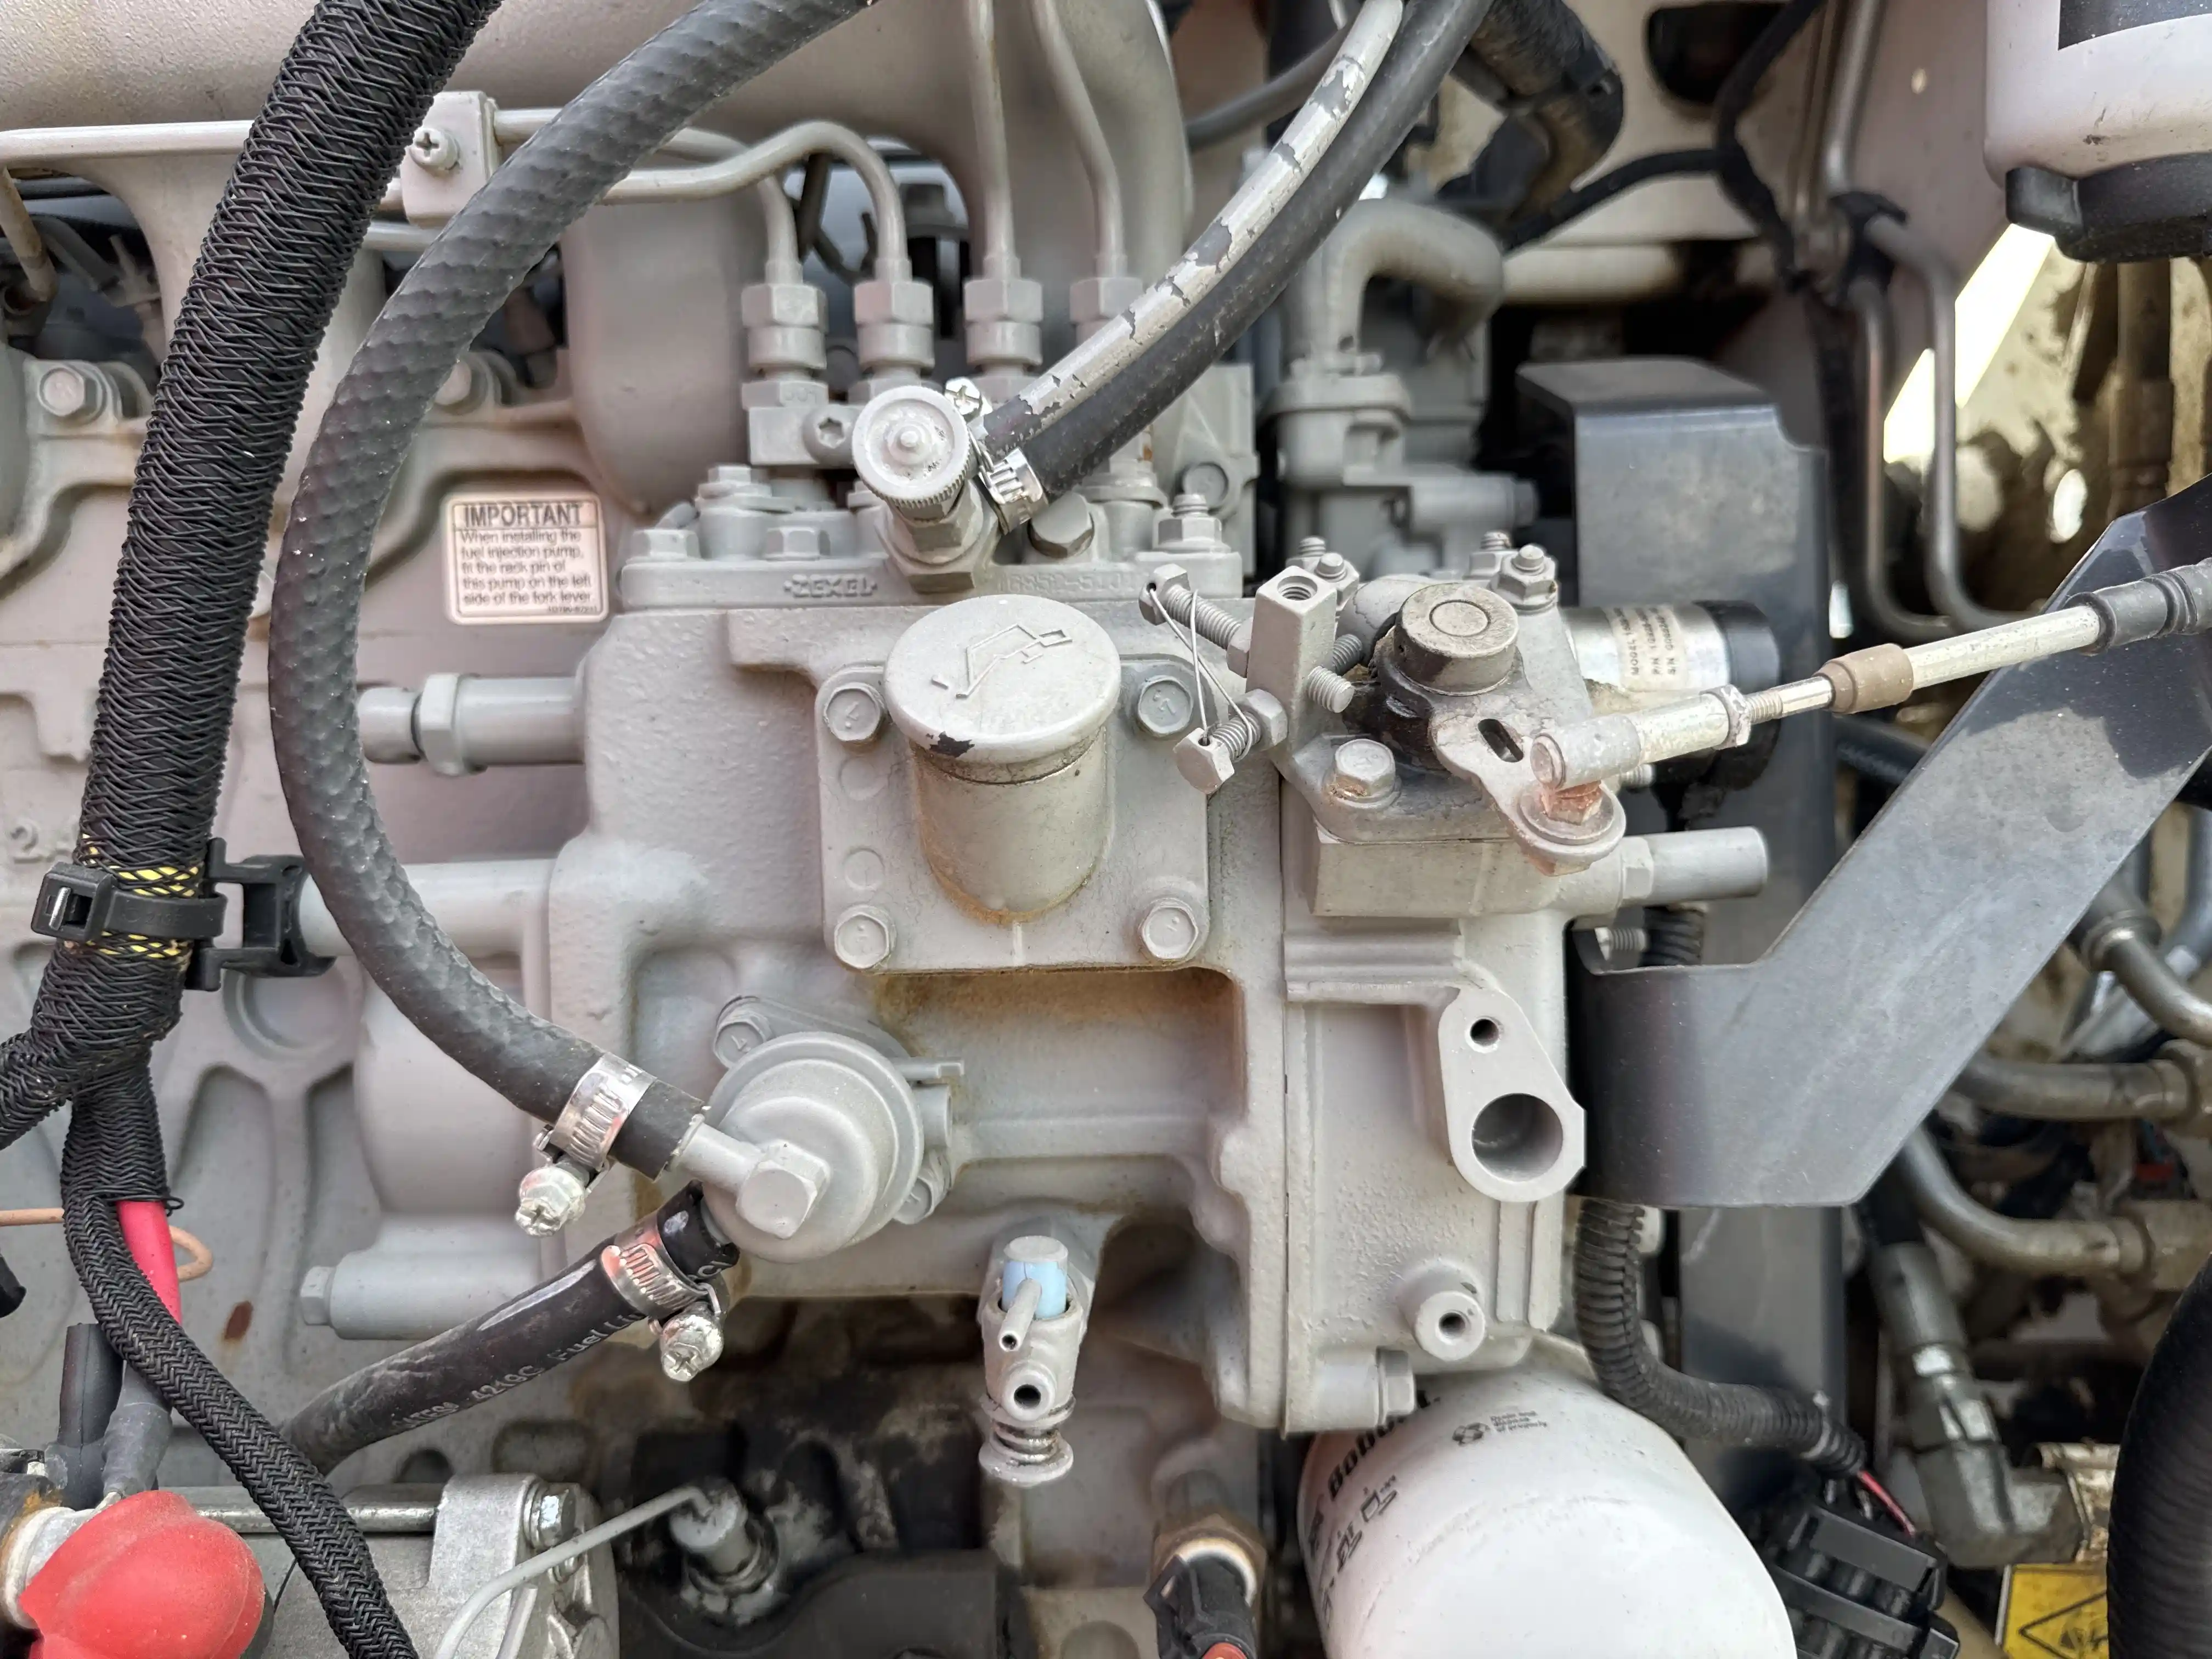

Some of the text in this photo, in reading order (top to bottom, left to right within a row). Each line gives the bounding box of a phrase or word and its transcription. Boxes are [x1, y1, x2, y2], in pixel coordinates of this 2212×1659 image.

[465, 503, 583, 527] IMPORTANT
[460, 526, 582, 545] When installing the
[461, 546, 484, 559] fuel
[488, 545, 540, 561] injection
[476, 561, 495, 574] the
[530, 561, 550, 575] pin
[553, 560, 566, 573] of
[462, 574, 591, 593] this pump on the left
[790, 573, 874, 599] ZEXEL
[463, 592, 490, 605] side
[493, 591, 506, 604] of
[510, 590, 530, 603] the
[533, 589, 556, 603] fork
[1627, 639, 1639, 676] MODEL
[548, 1328, 609, 1362] Fuel
